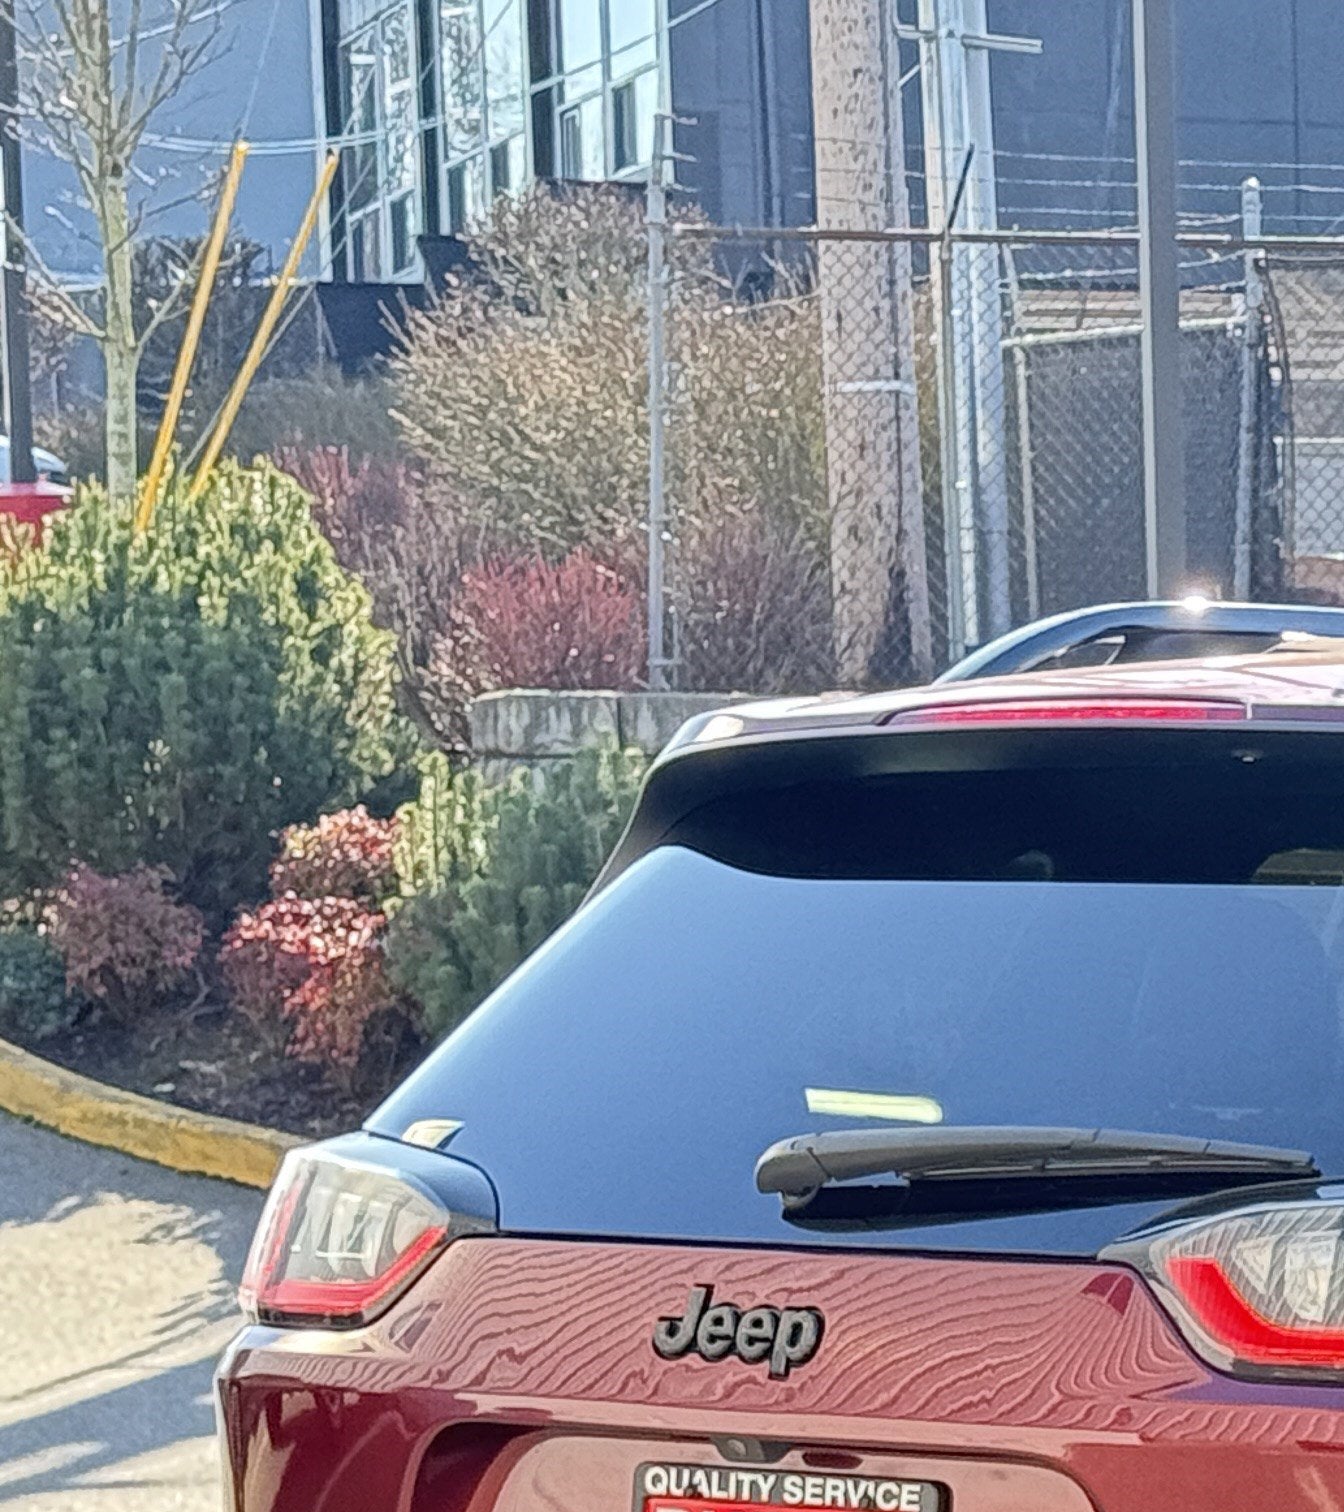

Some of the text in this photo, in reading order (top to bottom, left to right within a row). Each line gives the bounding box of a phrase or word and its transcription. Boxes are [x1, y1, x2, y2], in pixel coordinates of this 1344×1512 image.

[652, 1284, 825, 1381] Jeep
[644, 1466, 921, 1512] QUALITY SERVICE
